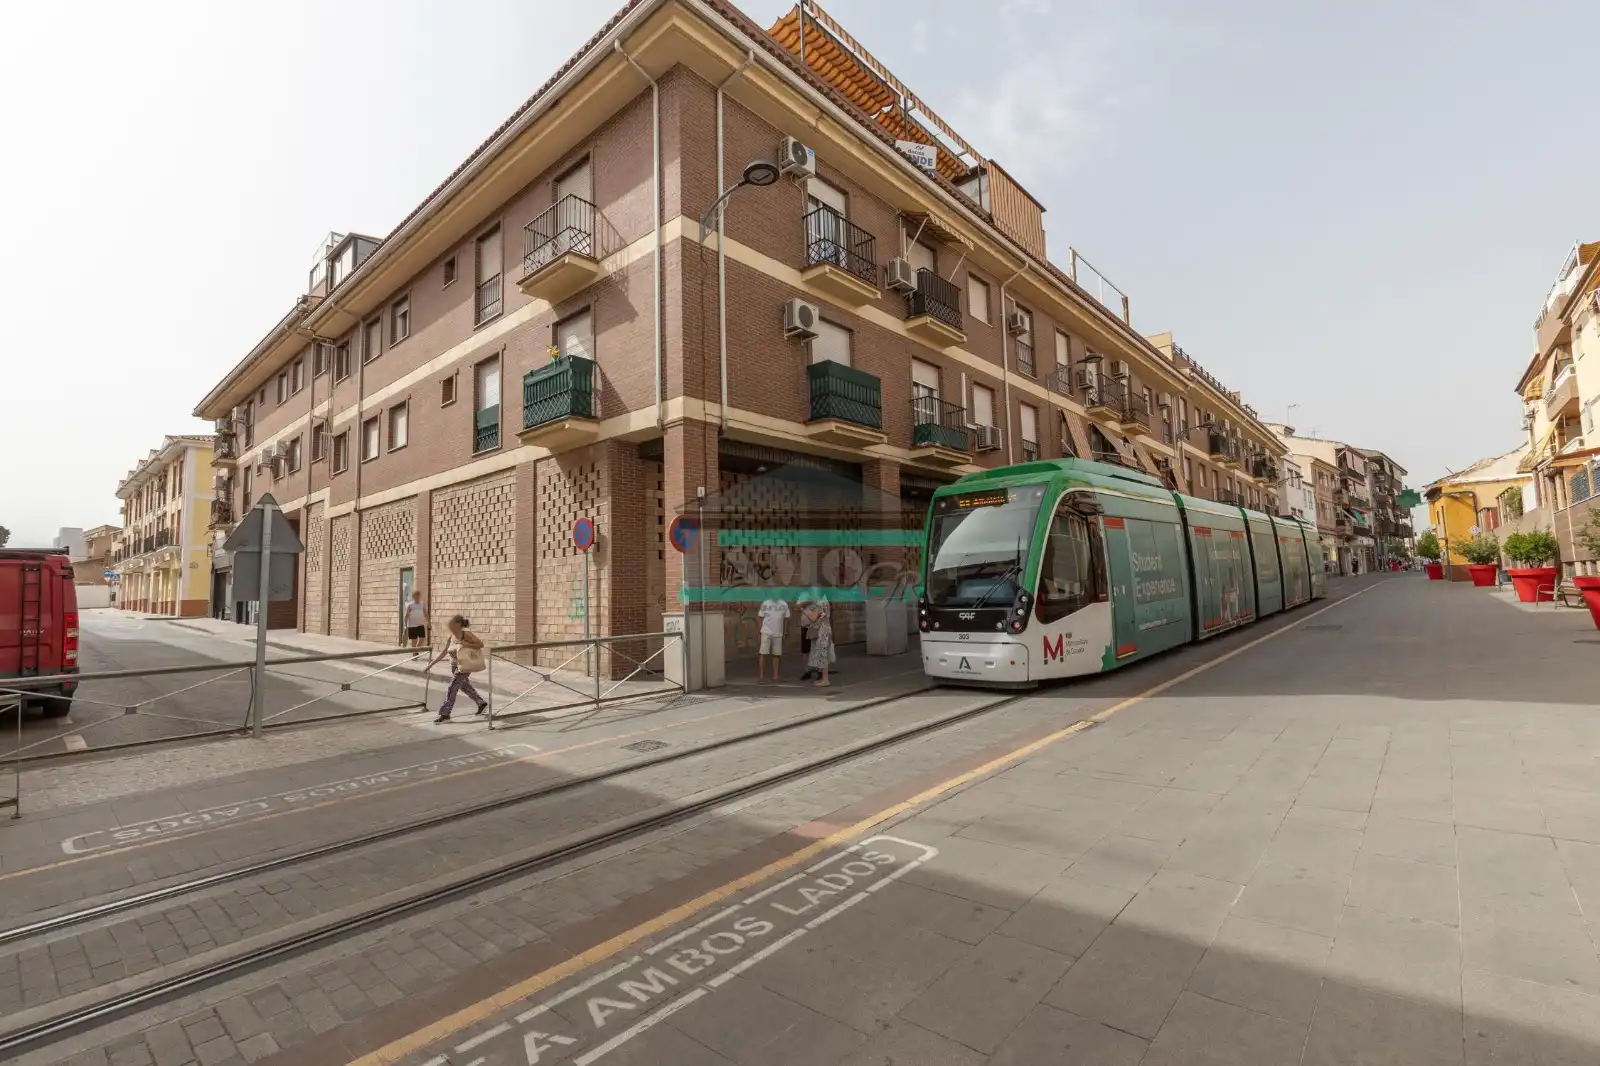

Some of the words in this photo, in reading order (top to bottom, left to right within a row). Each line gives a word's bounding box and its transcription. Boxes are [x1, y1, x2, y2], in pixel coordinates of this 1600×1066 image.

[912, 156, 933, 166] NDE
[1132, 552, 1162, 572] Student
[1135, 577, 1176, 601] Experience
[112, 800, 270, 840] LADOS
[523, 1028, 578, 1066] A
[585, 916, 774, 1029] AMBOS
[770, 848, 898, 917] LADOS
